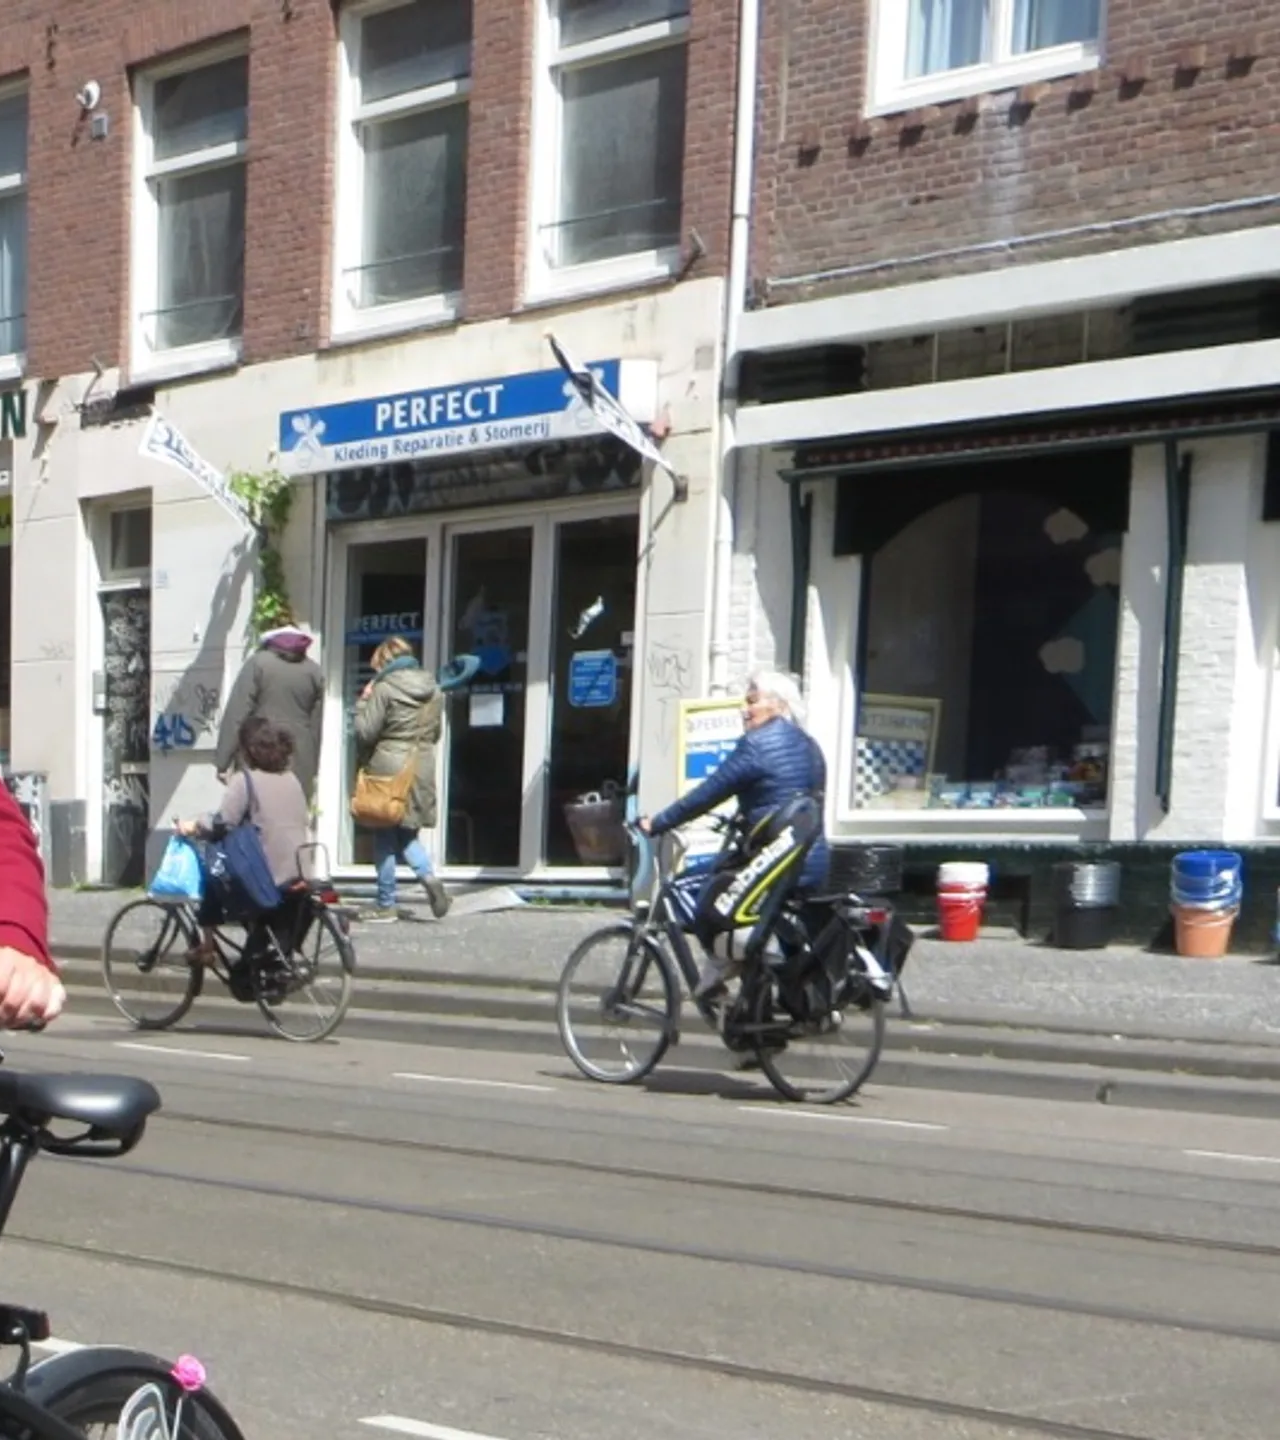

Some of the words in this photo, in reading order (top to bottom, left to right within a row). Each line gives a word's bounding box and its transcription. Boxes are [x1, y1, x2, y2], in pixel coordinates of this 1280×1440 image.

[375, 384, 504, 431] PERFECT
[334, 443, 388, 462] Kleding
[393, 430, 464, 457] Reparatie
[469, 428, 479, 444] &
[484, 418, 551, 442] Stomerij
[696, 713, 739, 731] PERFEC
